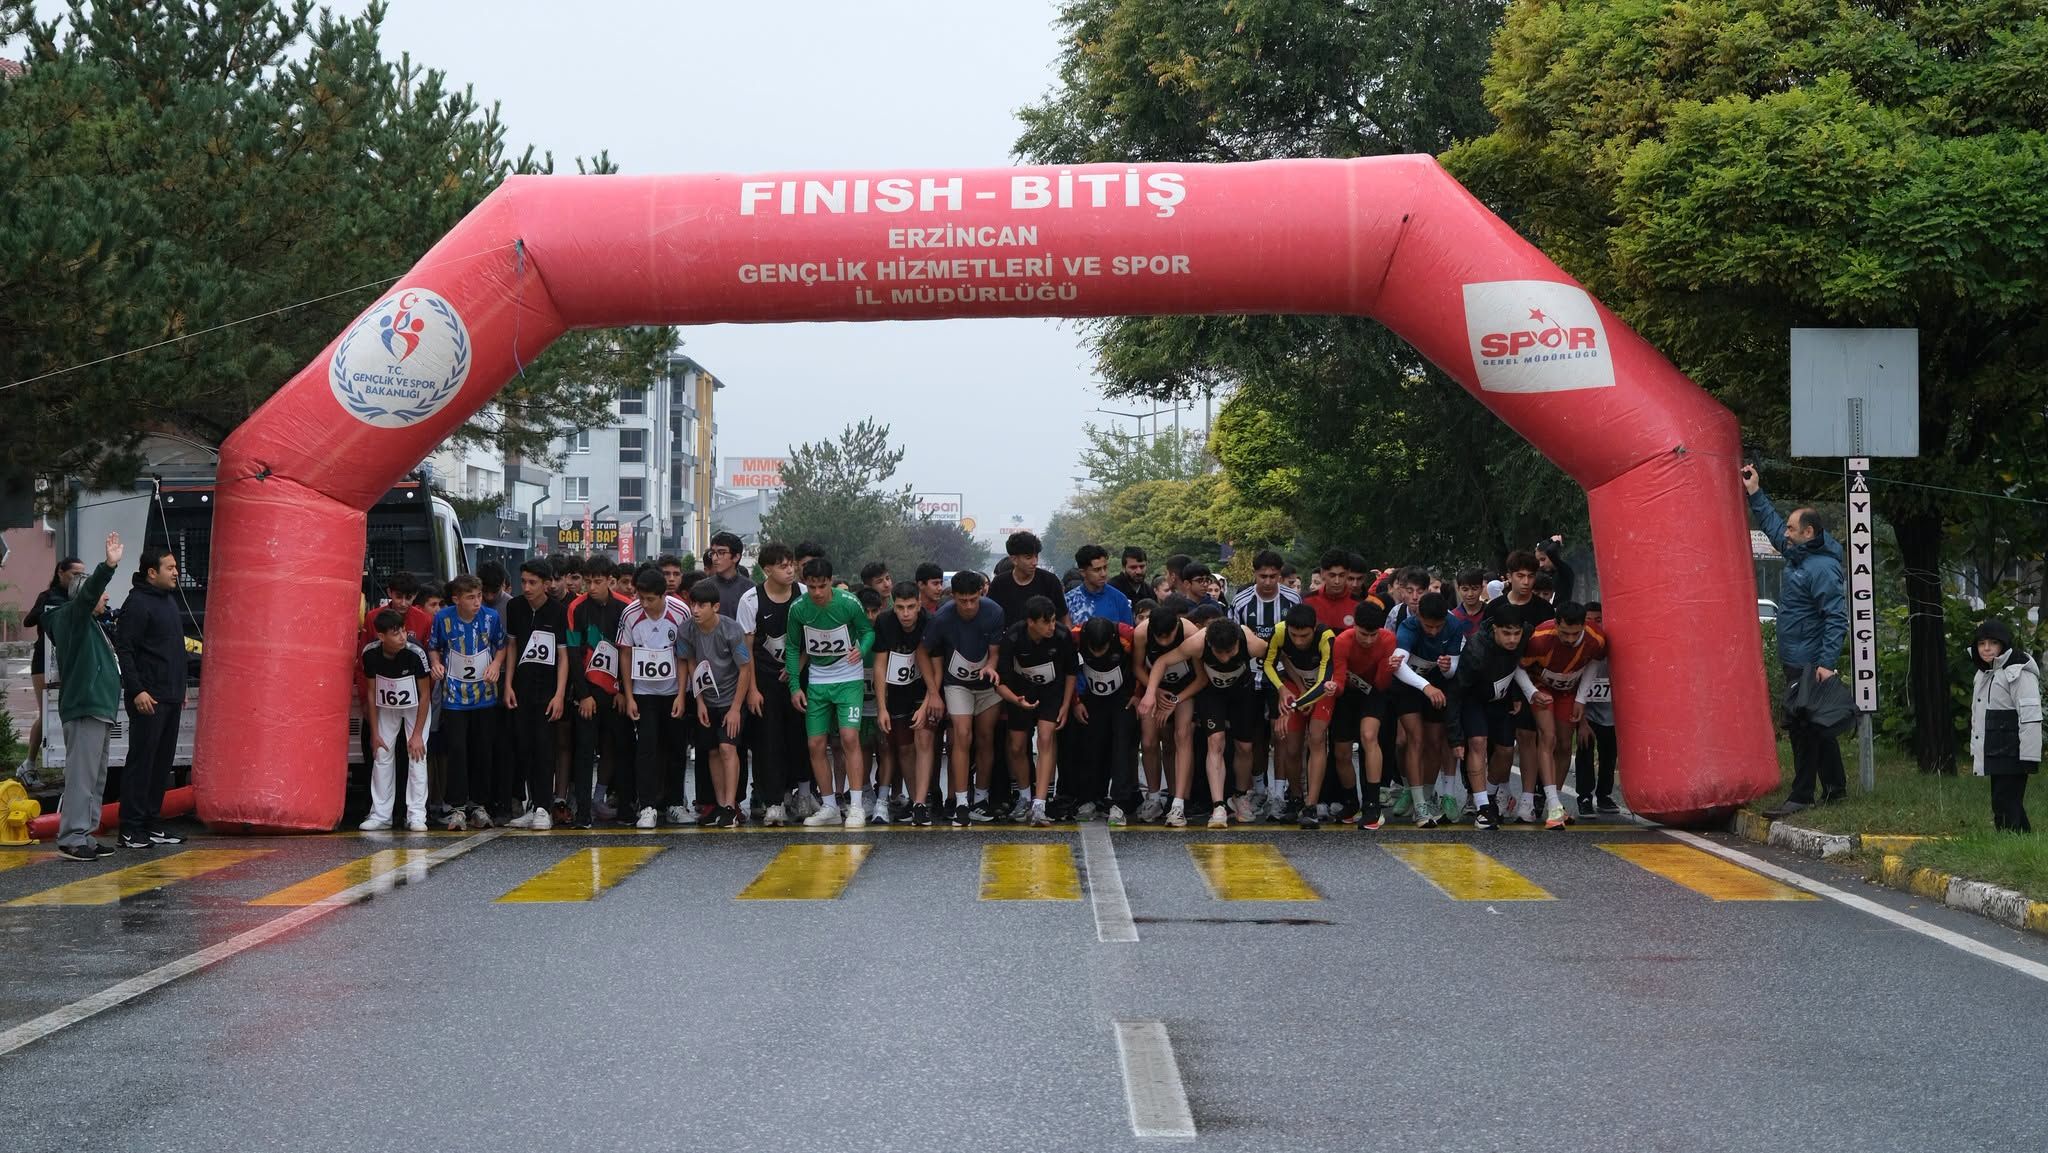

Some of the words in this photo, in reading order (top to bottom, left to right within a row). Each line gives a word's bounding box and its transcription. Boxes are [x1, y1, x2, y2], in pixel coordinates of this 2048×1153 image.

[740, 177, 963, 215] FINISH
[1011, 168, 1187, 218] BİTİŞ
[888, 223, 1038, 248] ERZİNCAN
[738, 257, 868, 287] GENÇLİK
[877, 253, 1053, 280] HİZMETLERİ
[1063, 258, 1101, 276] VE
[1112, 255, 1191, 275] SPOR
[855, 285, 883, 305] İL
[892, 280, 1078, 304] MÜDÜRLÜĞÜ
[1480, 327, 1596, 358] SPOR
[1482, 358, 1519, 366] GENEL
[387, 365, 404, 376] T.C.
[396, 377, 409, 387] VE
[410, 379, 436, 389] SPOR
[1852, 501, 1870, 575] YAYA
[809, 639, 847, 653] 222
[1854, 589, 1874, 701] GEÇİDİ
[463, 667, 476, 679] 2
[638, 661, 671, 677] 160
[898, 664, 916, 681] 98
[696, 672, 714, 689] 16
[1088, 677, 1116, 693] 101
[379, 689, 412, 705] 162
[847, 706, 860, 718] 13
